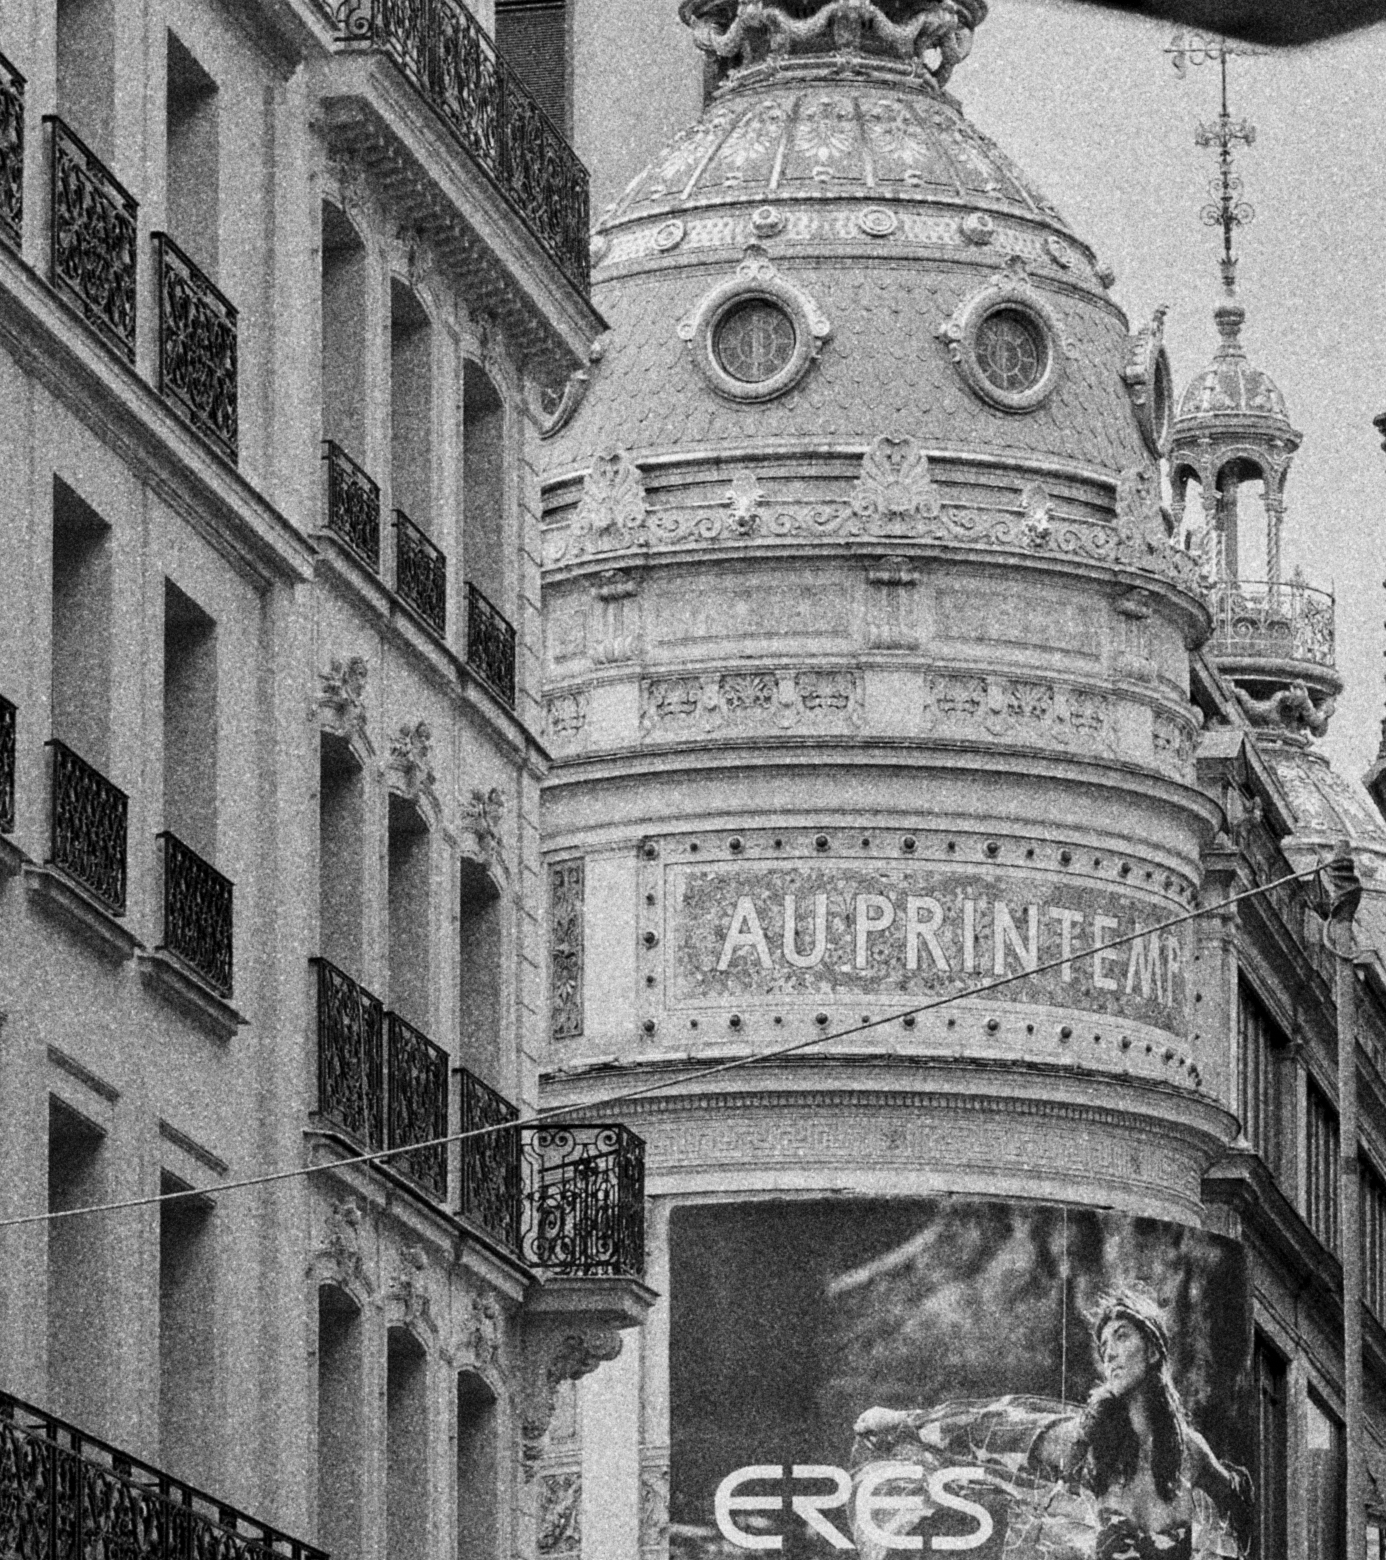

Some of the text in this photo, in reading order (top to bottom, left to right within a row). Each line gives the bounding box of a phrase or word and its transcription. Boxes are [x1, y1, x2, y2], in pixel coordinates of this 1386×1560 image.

[715, 893, 1181, 1008] AU PRINTEMP
[714, 1464, 995, 1550] ERES
